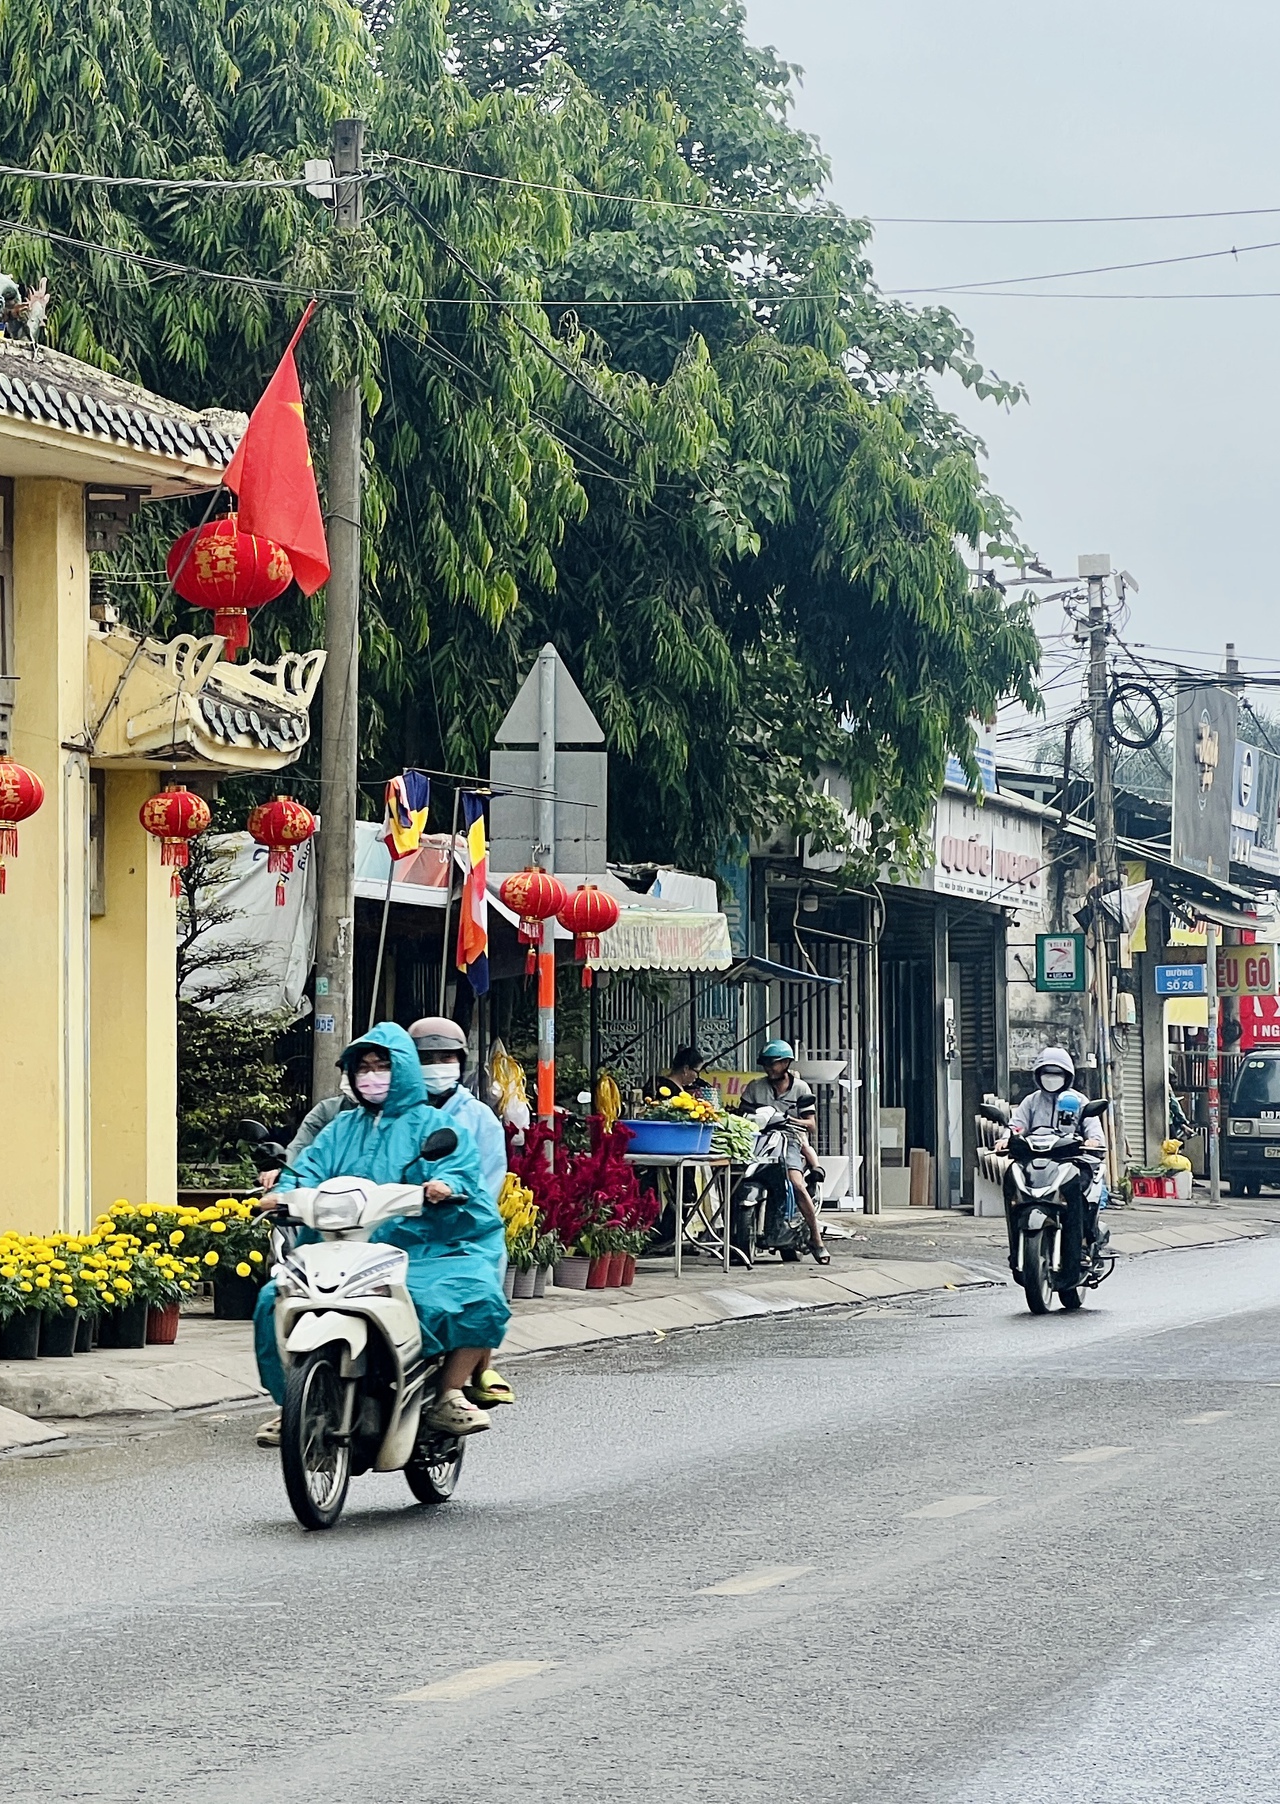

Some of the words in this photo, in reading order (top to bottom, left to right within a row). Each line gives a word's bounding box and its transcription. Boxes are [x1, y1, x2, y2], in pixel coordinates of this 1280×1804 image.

[1245, 952, 1271, 987] GỖ
[1166, 978, 1181, 991] SỐ
[1182, 981, 1194, 990] 26
